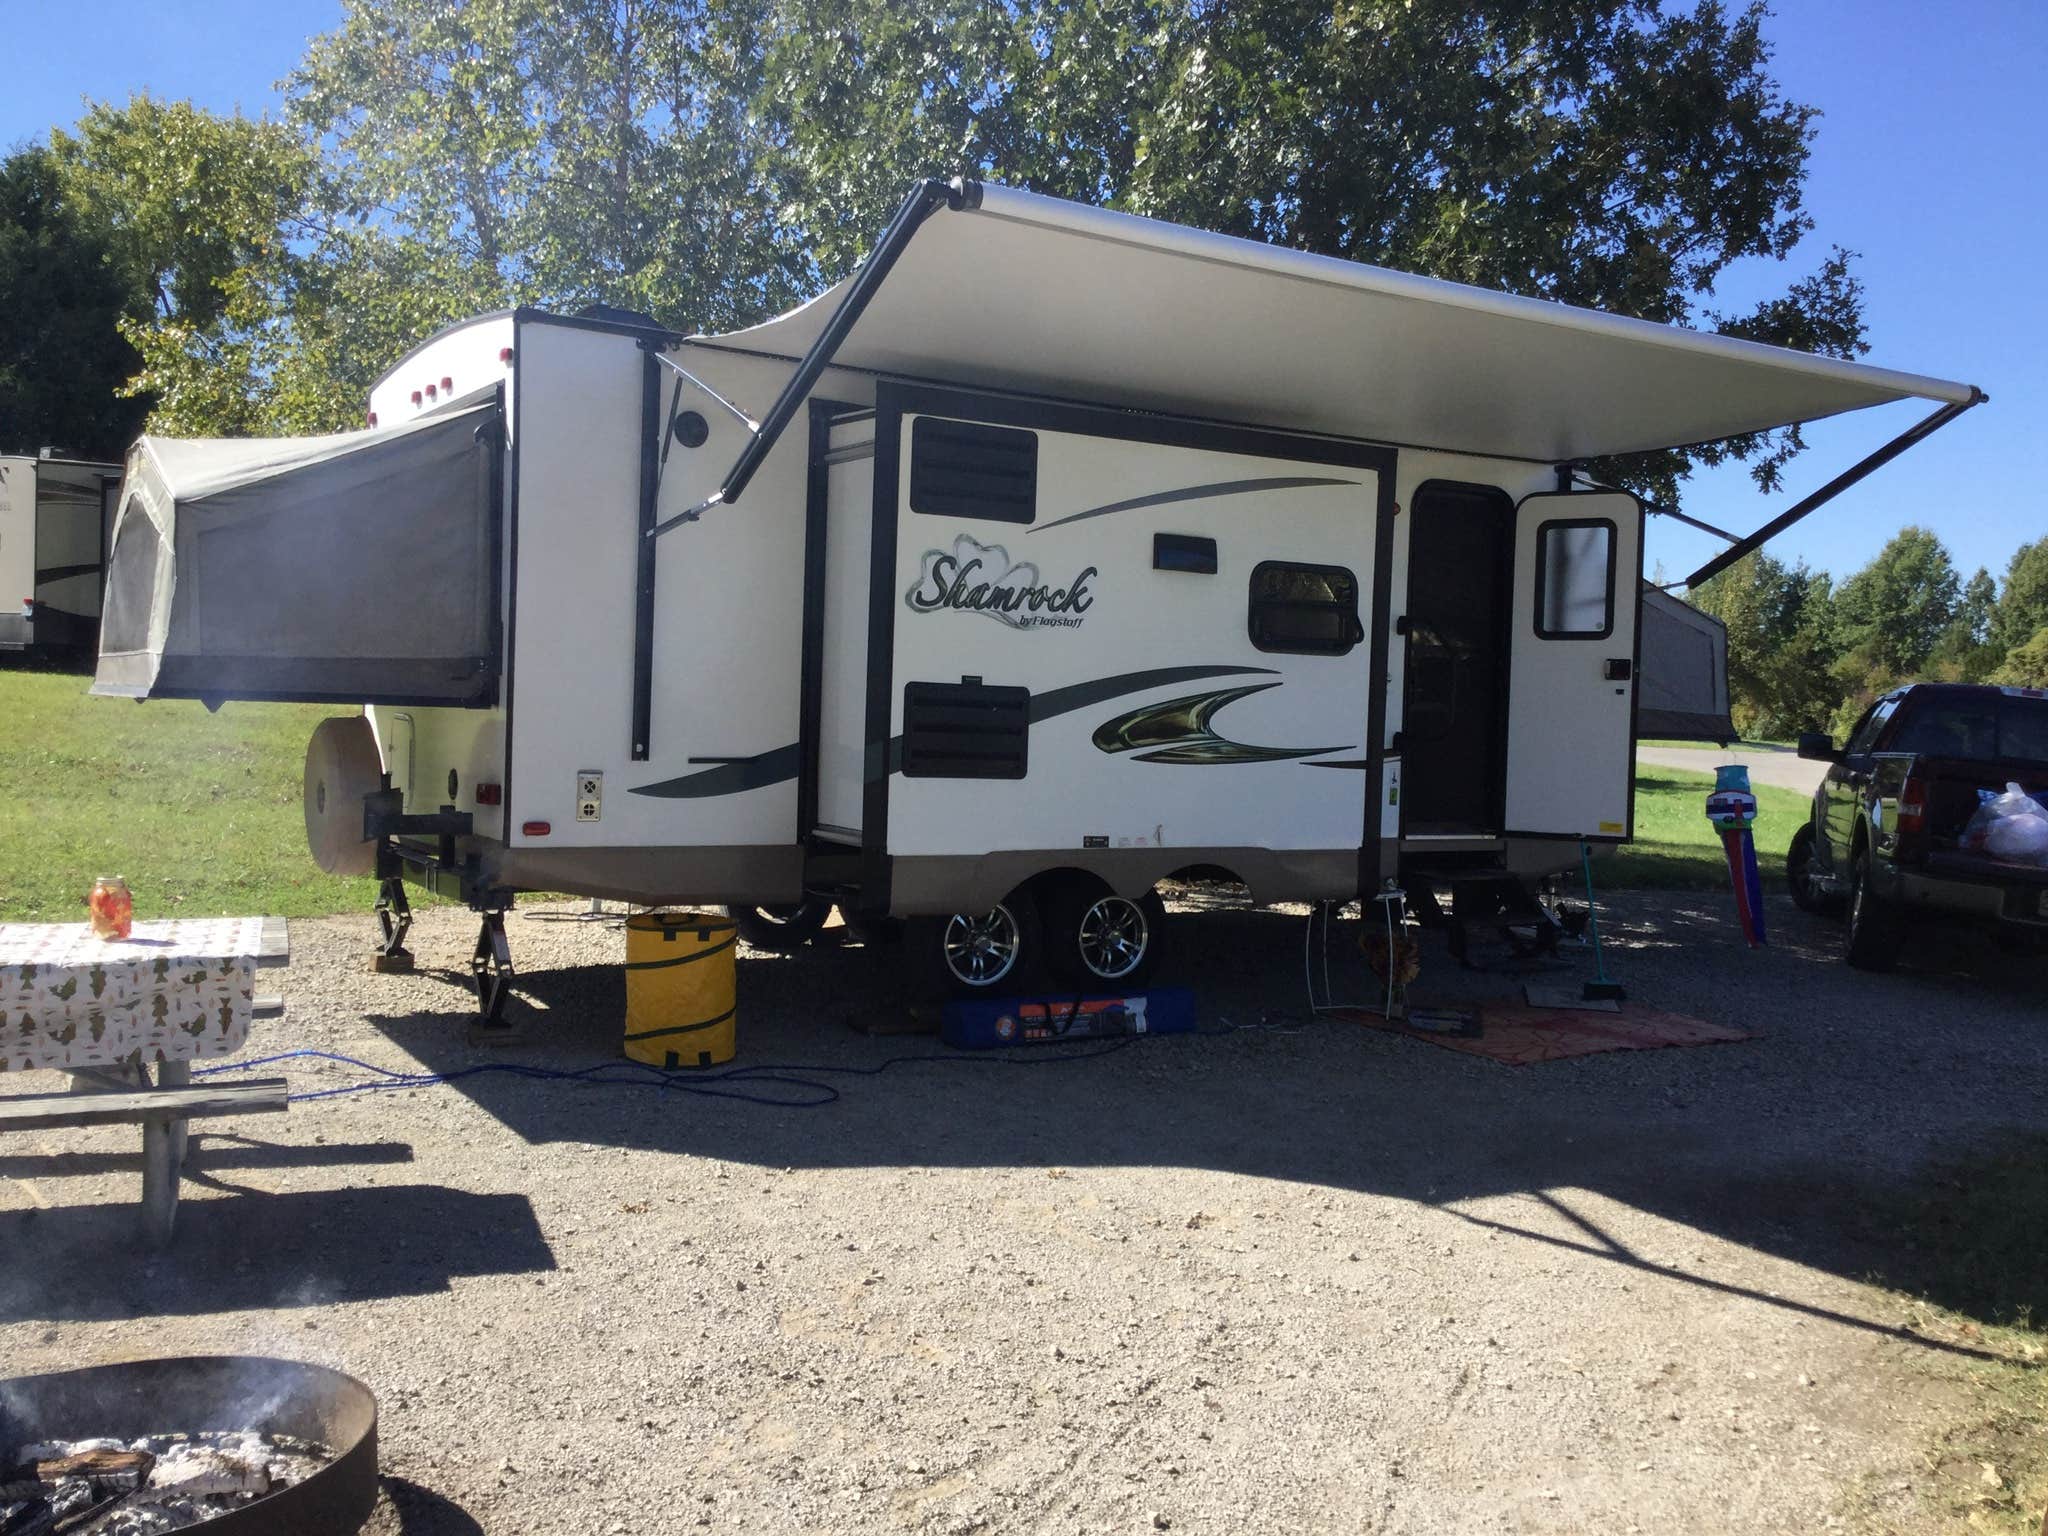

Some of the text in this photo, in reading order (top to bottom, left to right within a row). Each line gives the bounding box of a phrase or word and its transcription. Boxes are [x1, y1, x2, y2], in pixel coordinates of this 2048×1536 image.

[916, 555, 1098, 613] Shamrock
[1019, 615, 1084, 629] by Flagstaff
